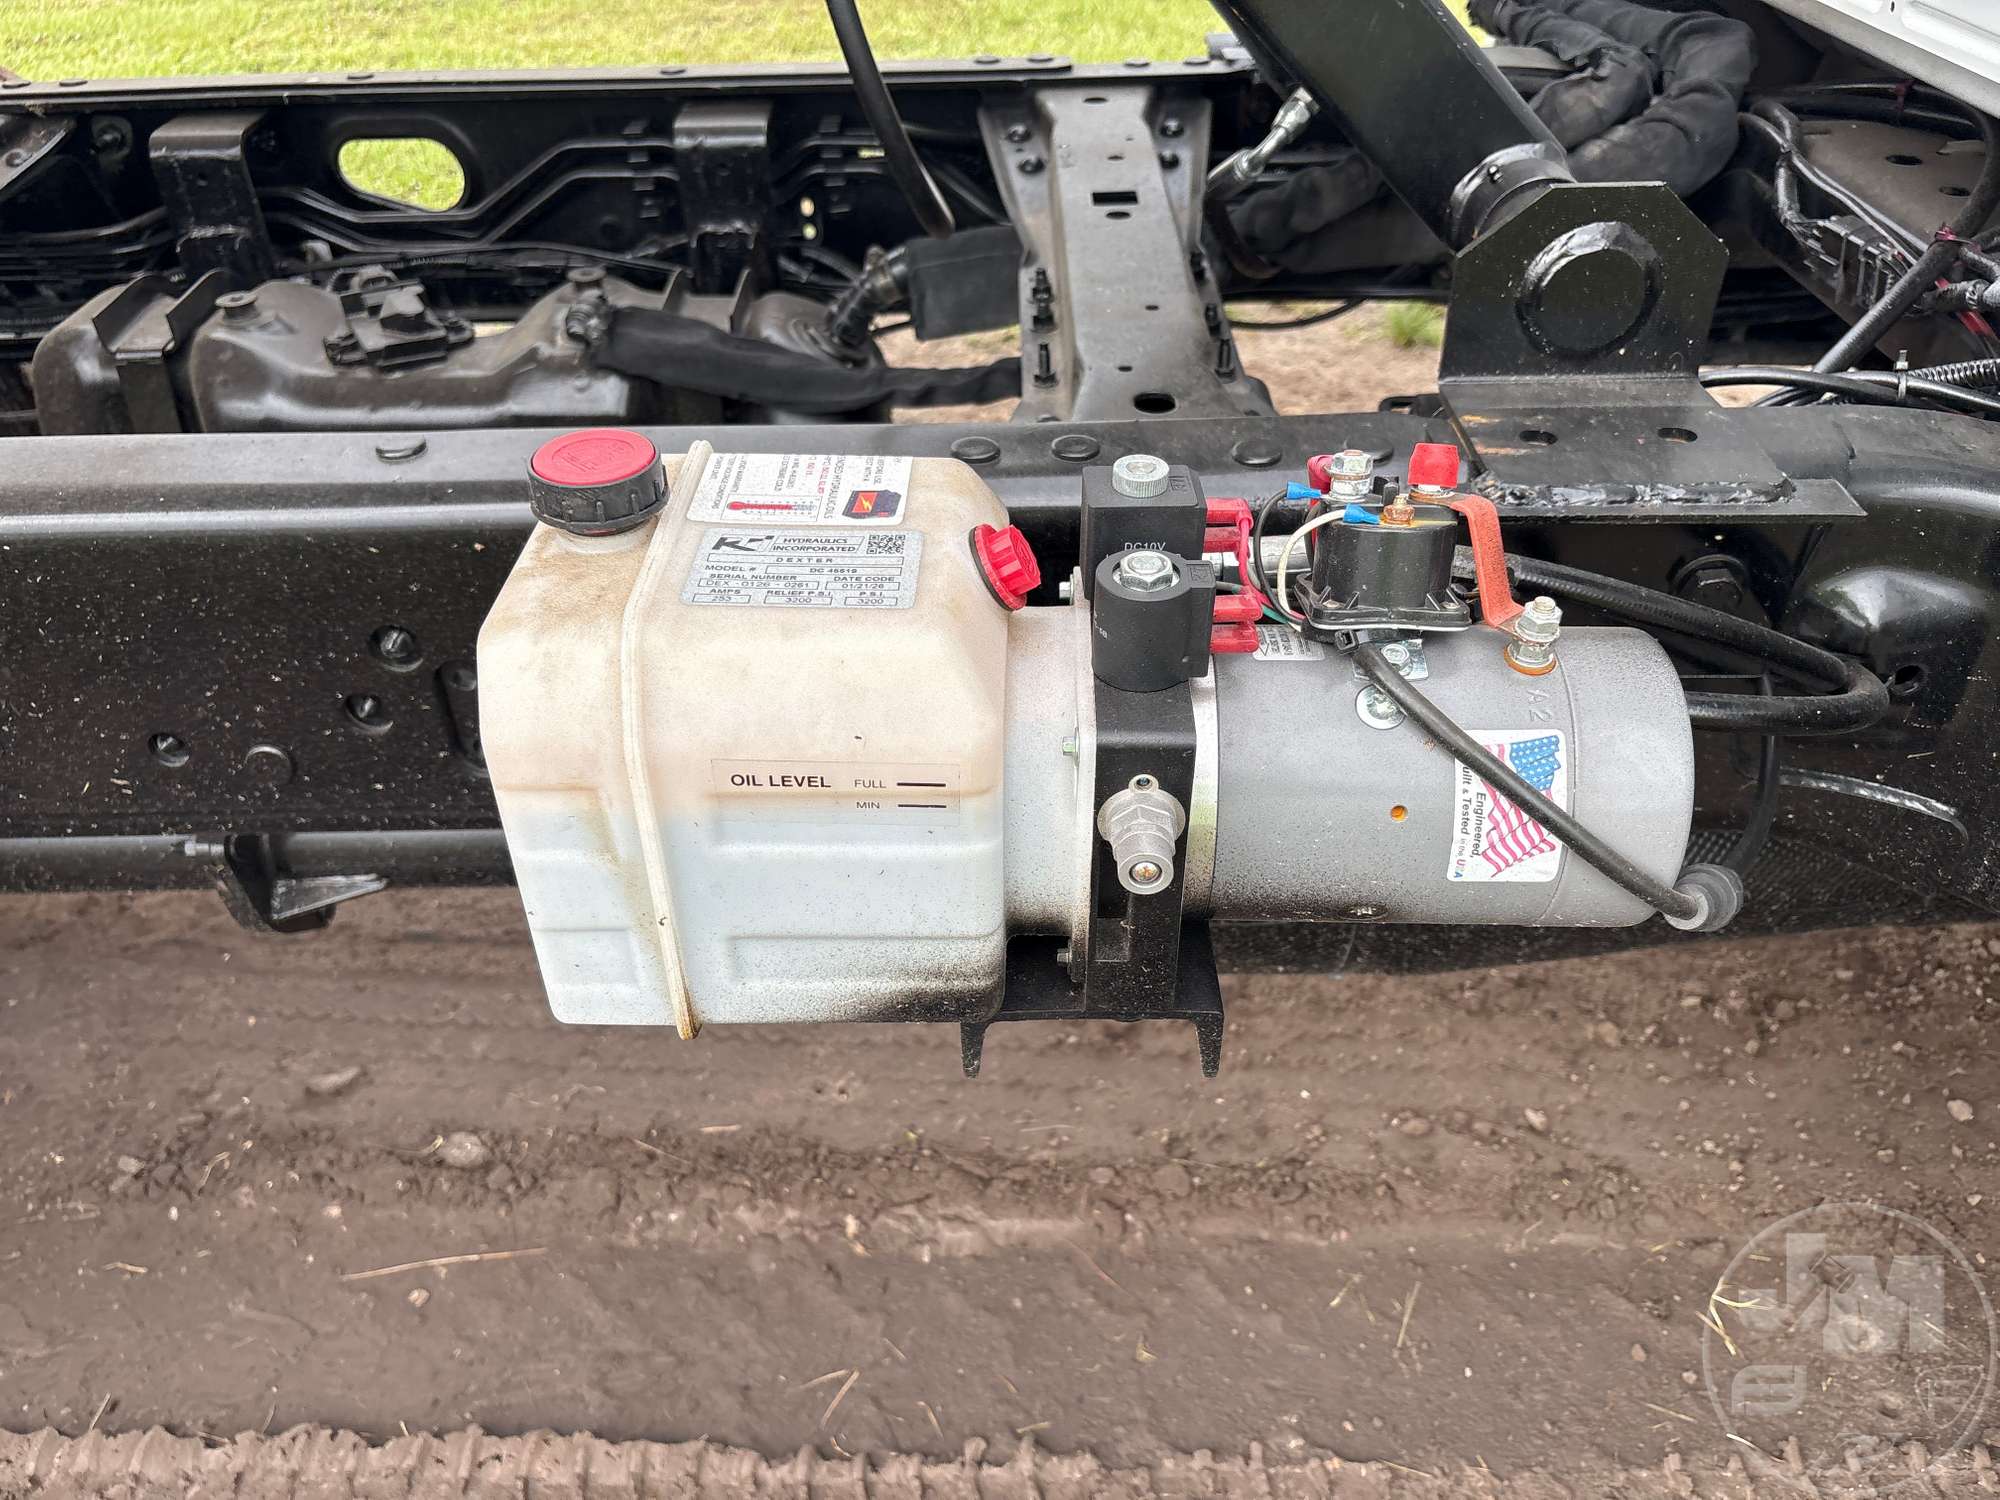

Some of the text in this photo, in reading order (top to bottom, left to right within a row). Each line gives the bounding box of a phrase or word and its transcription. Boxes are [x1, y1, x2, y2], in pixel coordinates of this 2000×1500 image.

[731, 774, 832, 788] OIL LEVEL
[1462, 766, 1473, 785] uilt
[854, 779, 887, 789] FULL
[856, 801, 880, 809] MIN
[1460, 797, 1473, 836] Tested
[1470, 791, 1487, 858] Engineered,
